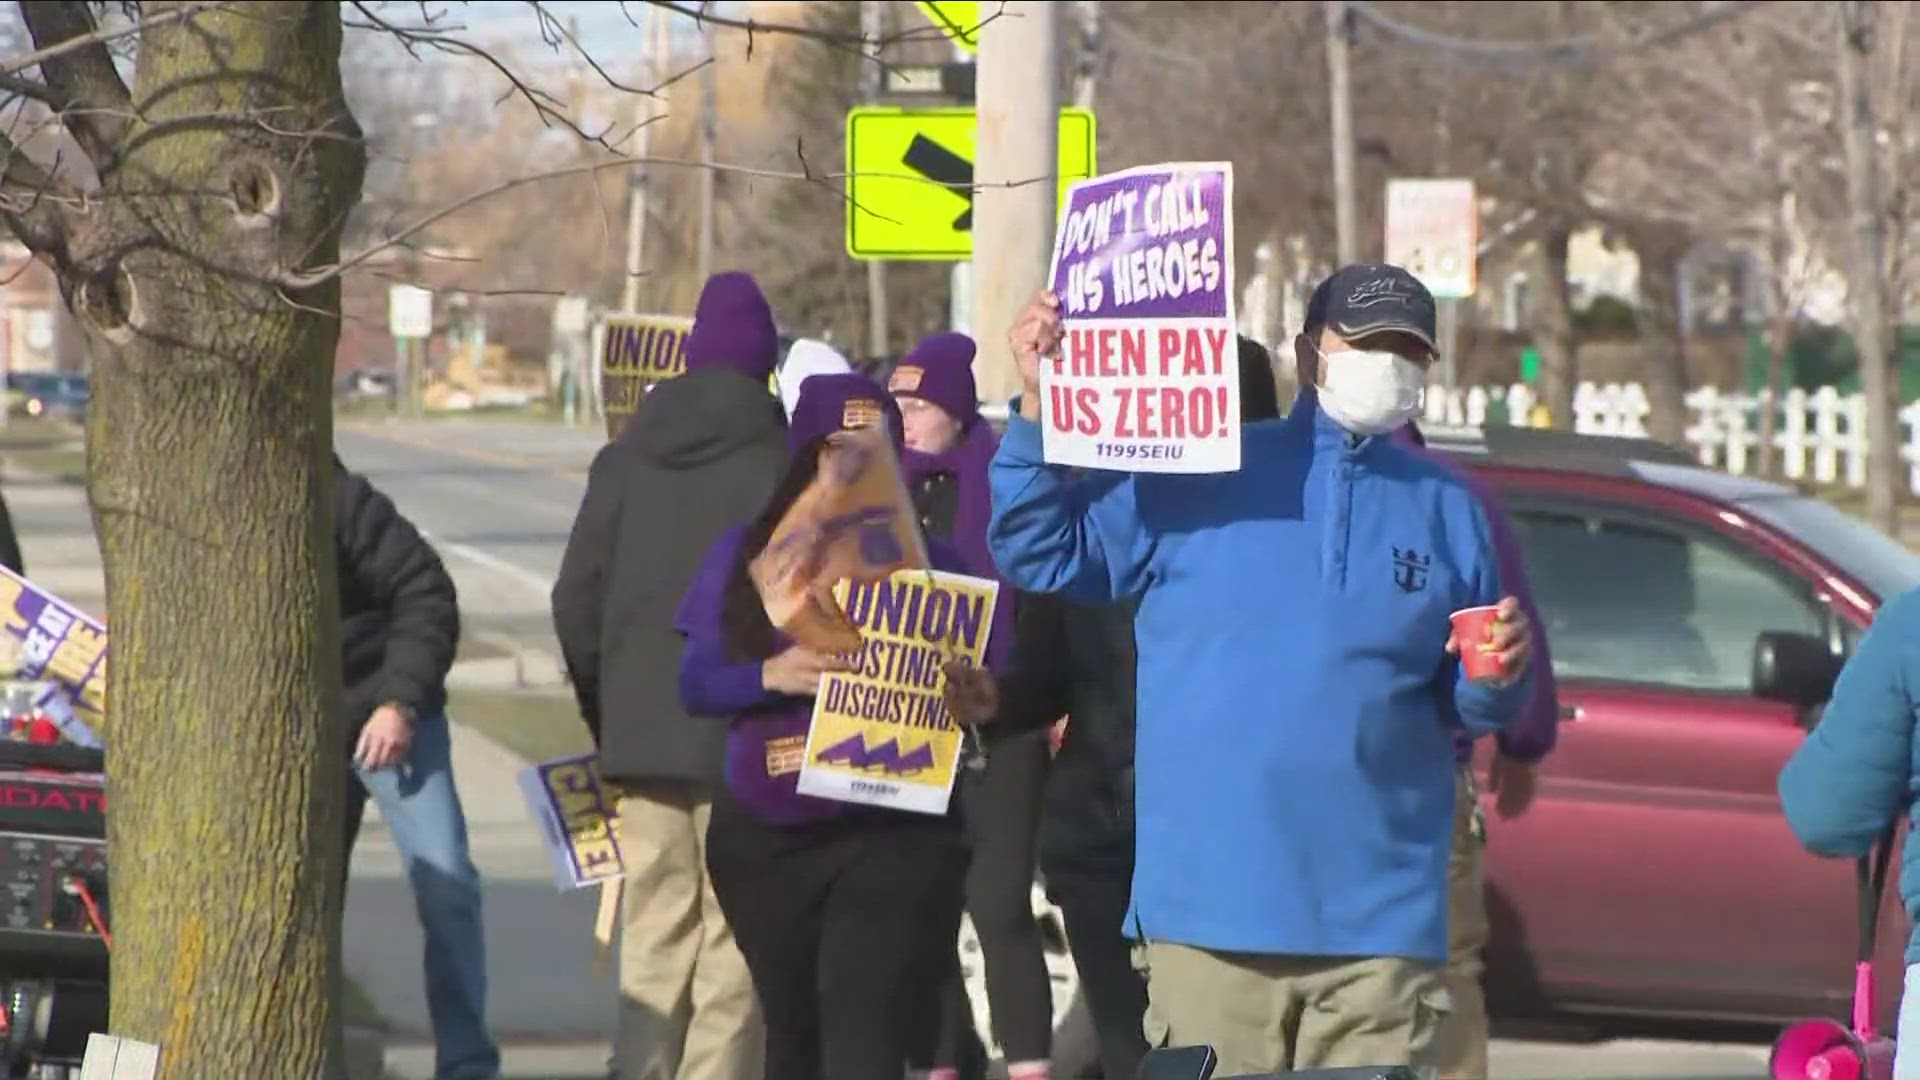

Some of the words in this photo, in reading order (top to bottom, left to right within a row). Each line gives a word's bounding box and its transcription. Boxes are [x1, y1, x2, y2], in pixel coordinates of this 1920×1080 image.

[1062, 189, 1138, 260] DON'T
[1145, 178, 1209, 237] CALL
[1067, 255, 1104, 314] US
[1112, 237, 1221, 307] HEROES
[1158, 328, 1227, 377] PAY
[1050, 385, 1101, 434] US
[1113, 385, 1229, 439] ZERO!
[1096, 443, 1184, 460] 1199SEIU
[846, 577, 984, 649] UNION
[836, 637, 942, 688] USTING
